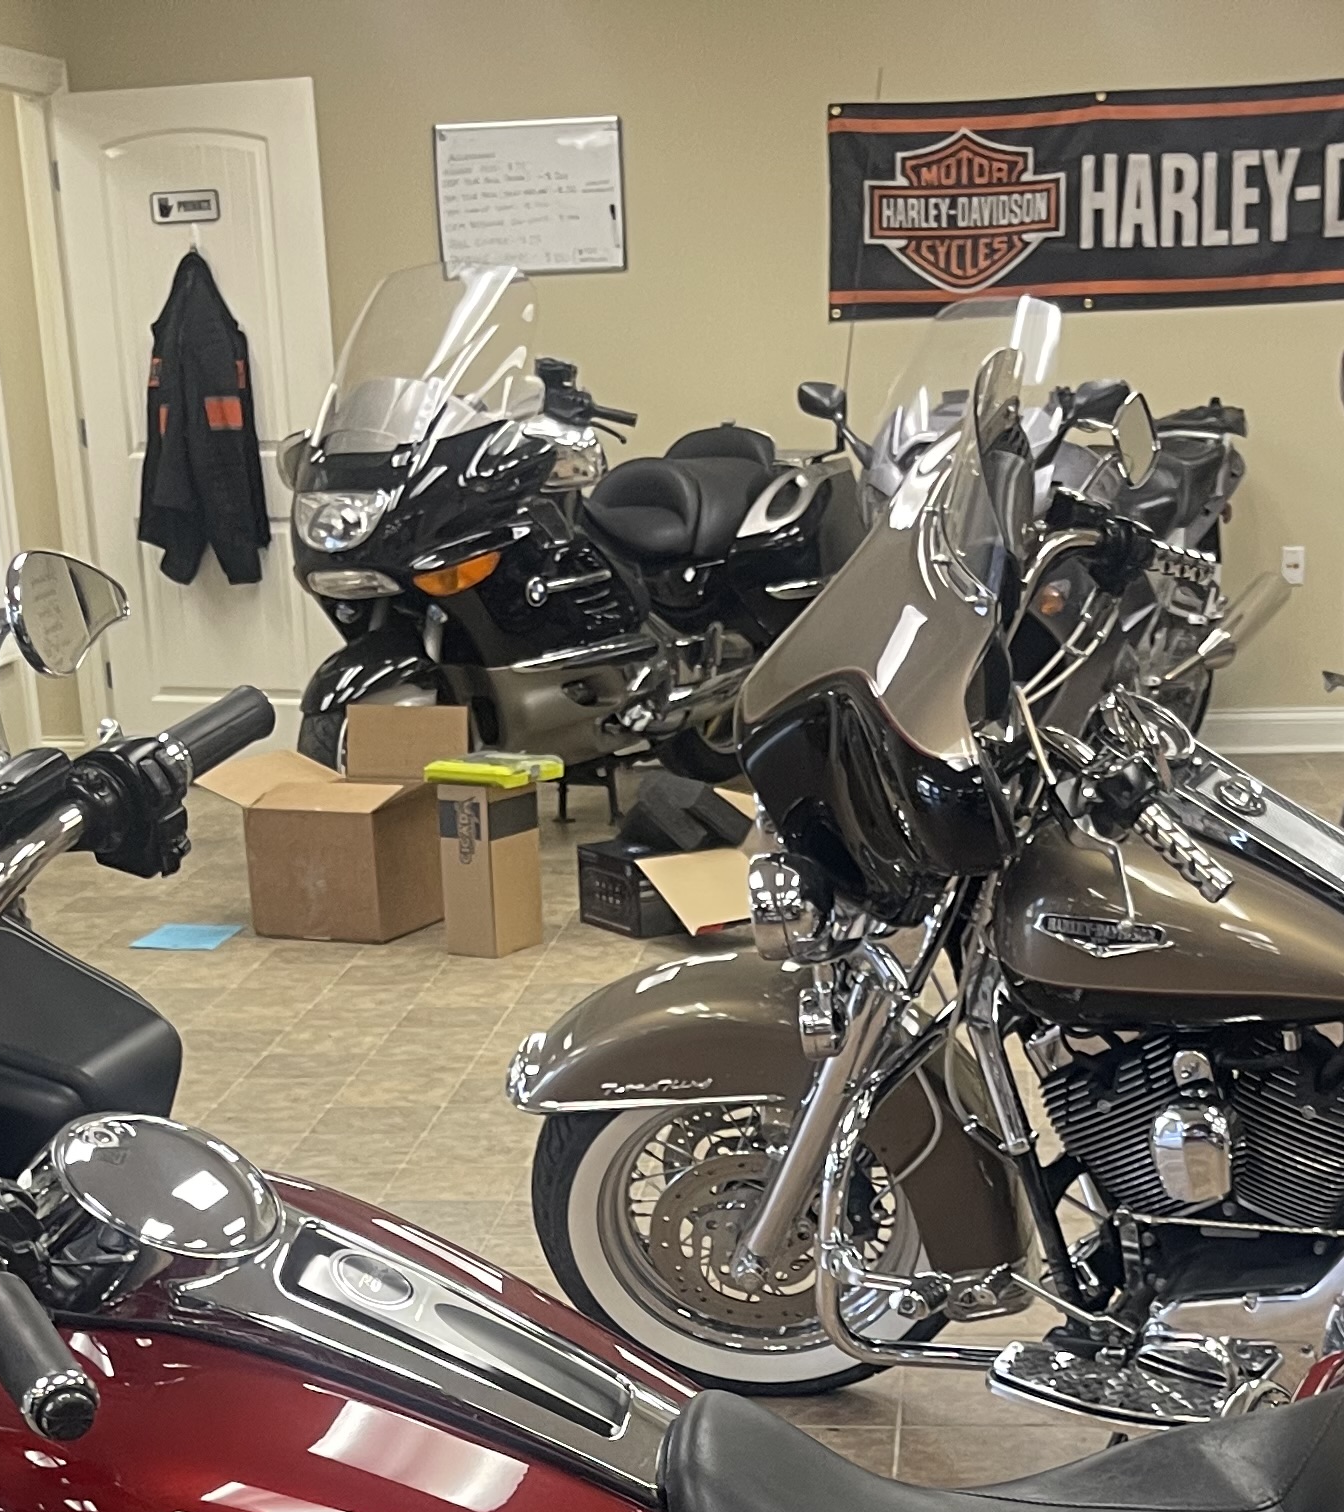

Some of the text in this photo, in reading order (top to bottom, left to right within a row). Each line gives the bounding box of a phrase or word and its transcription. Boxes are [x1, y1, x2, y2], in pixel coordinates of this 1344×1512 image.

[921, 150, 1009, 186] MOTOR
[881, 191, 1049, 228] HARLEY-DAVIDSON
[920, 236, 1009, 276] CYCLES
